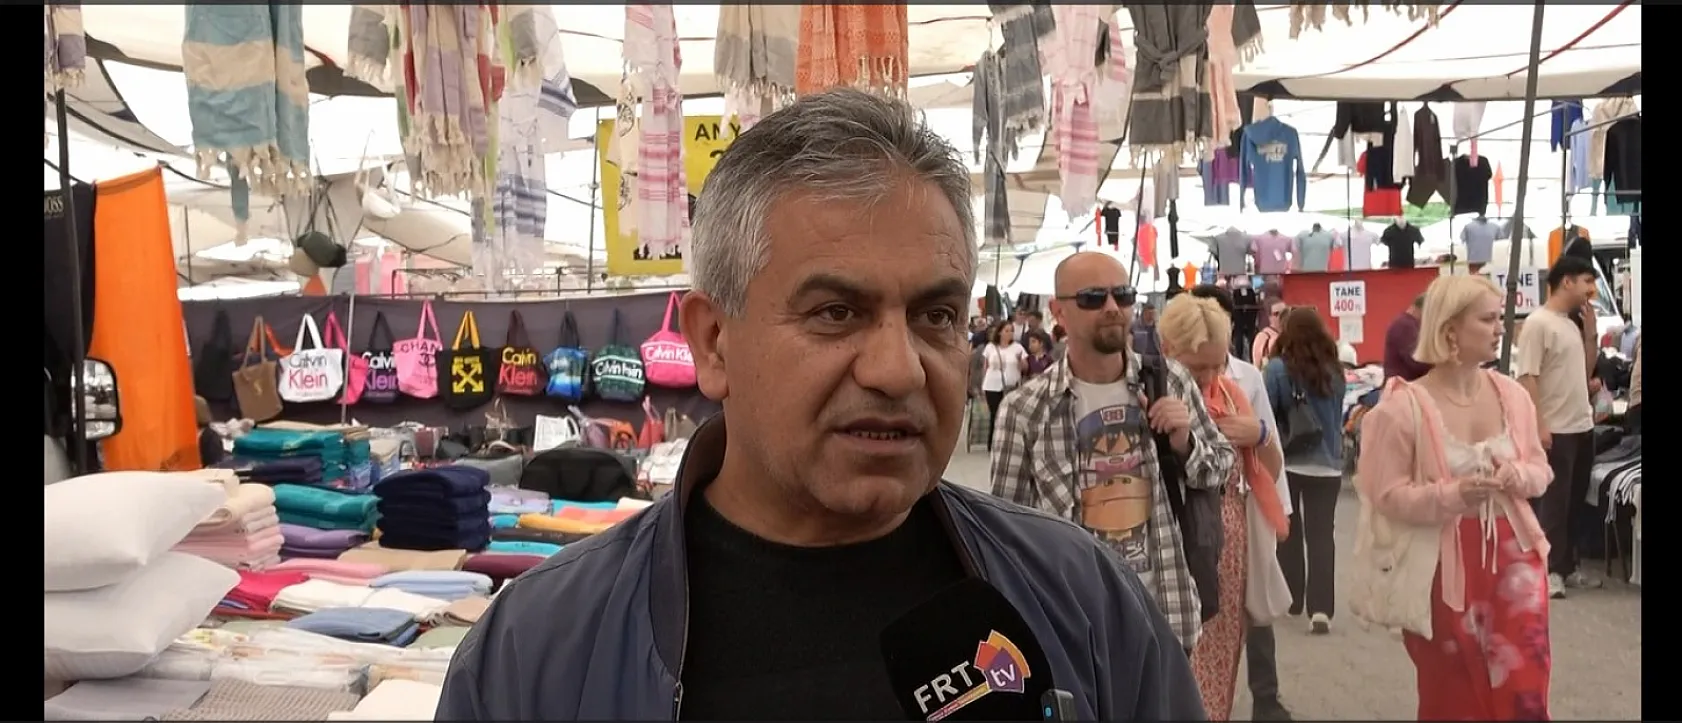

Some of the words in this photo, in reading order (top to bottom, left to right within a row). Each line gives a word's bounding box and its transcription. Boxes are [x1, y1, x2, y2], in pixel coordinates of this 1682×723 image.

[1496, 273, 1534, 287] TNE
[1335, 286, 1361, 296] TANE
[1334, 299, 1354, 311] 400
[289, 353, 327, 369] Calvin
[502, 347, 537, 366] Calvin
[288, 369, 328, 389] Klein
[499, 363, 537, 387] Klein
[913, 660, 973, 714] FRT
[990, 663, 1016, 687] tv
